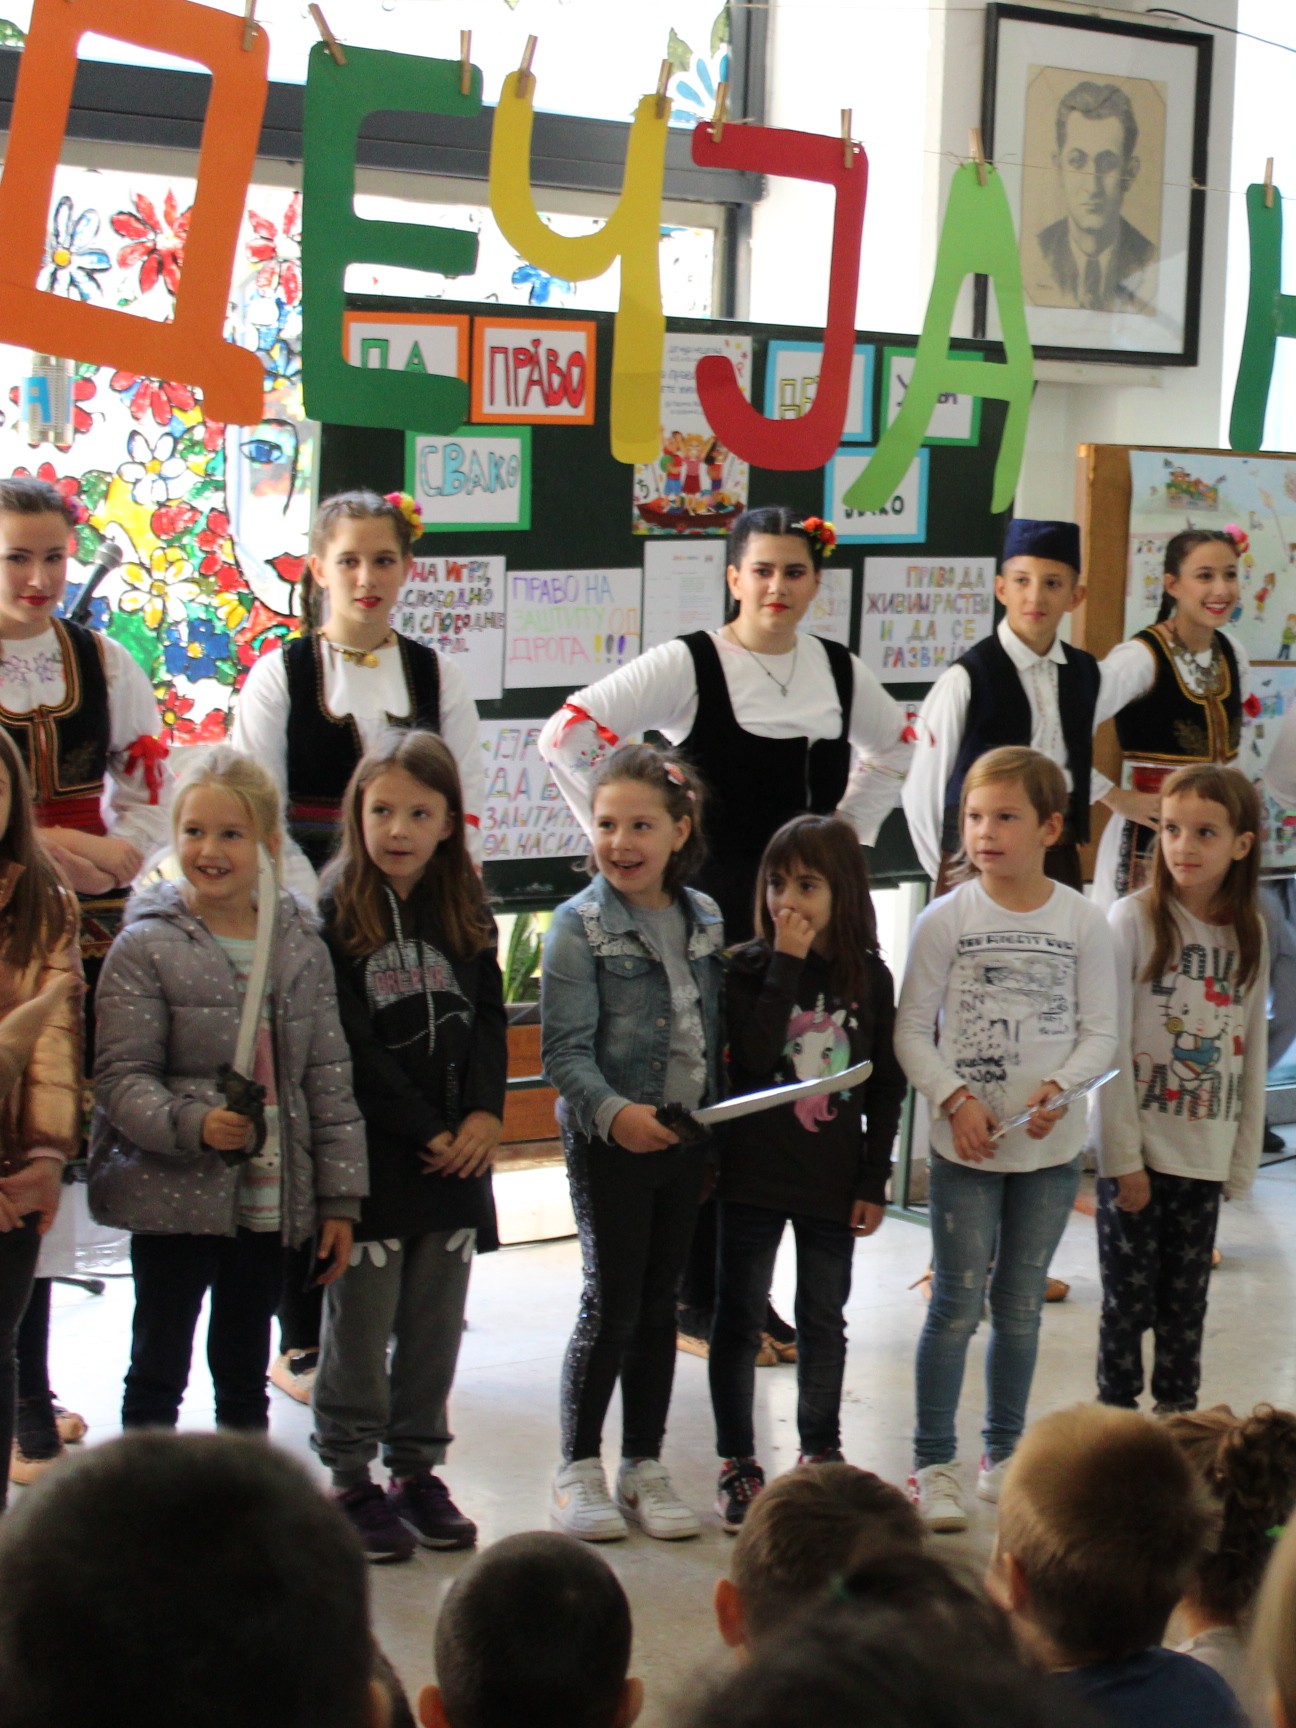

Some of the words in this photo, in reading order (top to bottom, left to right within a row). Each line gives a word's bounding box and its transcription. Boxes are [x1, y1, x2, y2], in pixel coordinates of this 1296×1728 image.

[489, 339, 587, 409] ПРАВО
[419, 443, 520, 498] СВАКО
[512, 574, 580, 605] ПРАВО
[584, 574, 616, 605] НА
[608, 607, 640, 636] ОД
[880, 620, 894, 641] И
[906, 619, 937, 644] ДА
[952, 619, 977, 641] СЕ
[509, 635, 592, 665] ДРОГА
